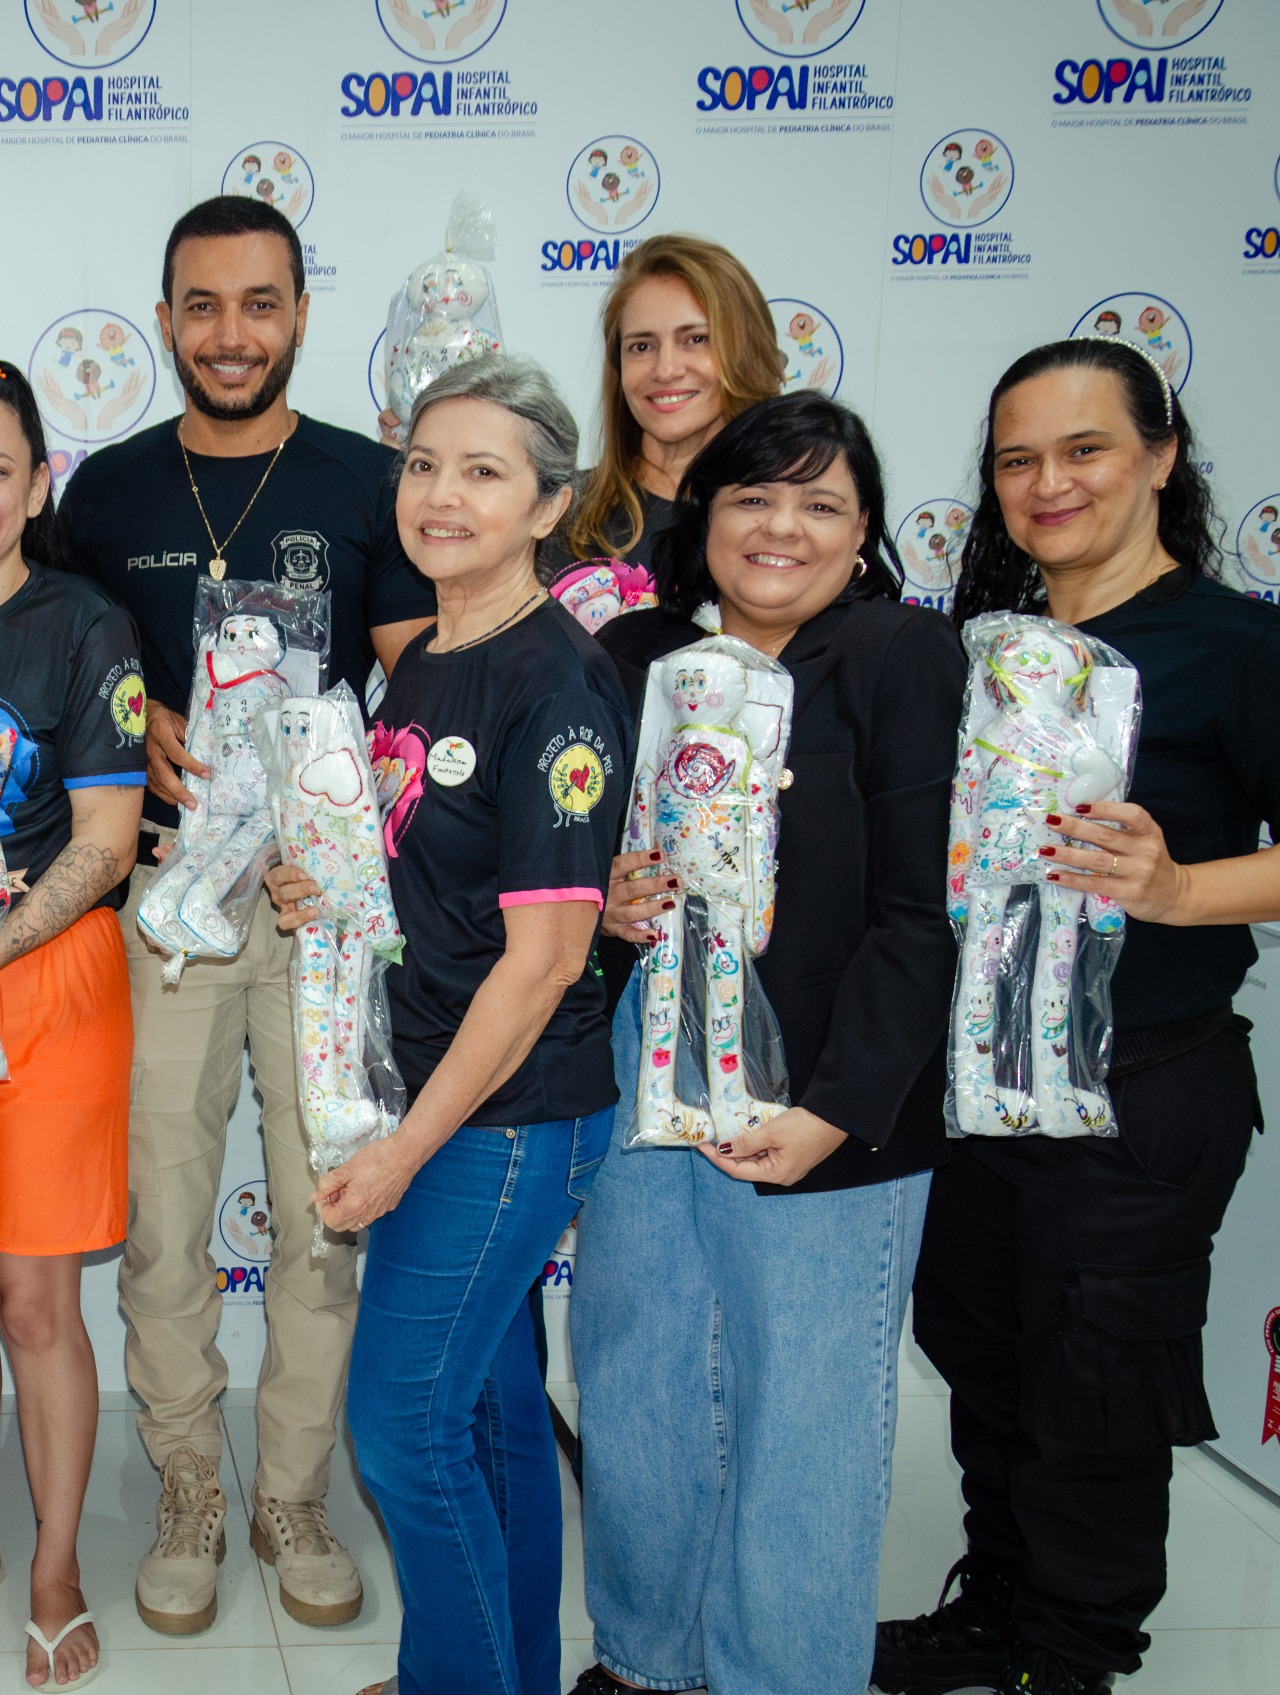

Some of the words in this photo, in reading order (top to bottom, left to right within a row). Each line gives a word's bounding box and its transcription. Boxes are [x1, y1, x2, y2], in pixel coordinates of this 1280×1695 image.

[1172, 56, 1227, 71] HOSPITAL
[813, 64, 868, 77] HOSPITAL
[108, 76, 162, 88] HOSPITAL
[457, 71, 510, 84] HOSPITAL
[1053, 57, 1168, 104] SOPAI
[1170, 72, 1223, 86] INFANTIL
[456, 87, 508, 100] INFANTIL
[696, 64, 809, 111] SOPAI
[812, 81, 864, 93] INFANTIL
[108, 92, 159, 104] INFANTIL
[340, 71, 452, 117] SOPAI
[1168, 85, 1251, 103] FILANTRÓPICO
[456, 99, 537, 115] FILANTRÓPICO
[812, 92, 893, 110] FILANTRÓPICO
[108, 104, 189, 120] FILANTRÓPICO
[703, 126, 730, 134] MAIOR
[731, 125, 766, 134] HOSPITAL
[780, 124, 820, 133] PEDIATRIA
[821, 123, 852, 132] CLÍNICA
[866, 123, 891, 132] BRASIL
[1, 137, 27, 145] MAIOR
[28, 136, 64, 145] HOSPITAL
[65, 136, 76, 144] DE
[77, 136, 118, 144] PEDIATRIA
[118, 134, 149, 143] CLÍNICA
[150, 135, 162, 143] DO
[163, 135, 188, 143] BRASIL
[348, 132, 375, 141] MAIOR
[376, 132, 411, 140] HOSPITAL
[412, 131, 424, 140] DE
[424, 131, 465, 139] PEDIATRIA
[466, 130, 497, 139] CLÍNICA
[498, 130, 510, 138] DO
[511, 130, 536, 138] BRASIL
[974, 232, 1013, 242] HOSPITAL
[891, 232, 971, 264] SOPAI
[974, 244, 1010, 253] INFANTIL
[541, 240, 620, 271] SOPAI
[973, 252, 1031, 264] FILANTRÓPICO
[285, 535, 315, 544] POLÍCIA
[128, 551, 197, 571] POLÍCIA
[290, 582, 314, 590] PENAL
[98, 664, 123, 699] PROJETO
[537, 734, 565, 772] PROJETO
[568, 726, 576, 741] À
[580, 726, 593, 742] FLOR
[593, 736, 605, 754] DA
[602, 754, 613, 776] PELE
